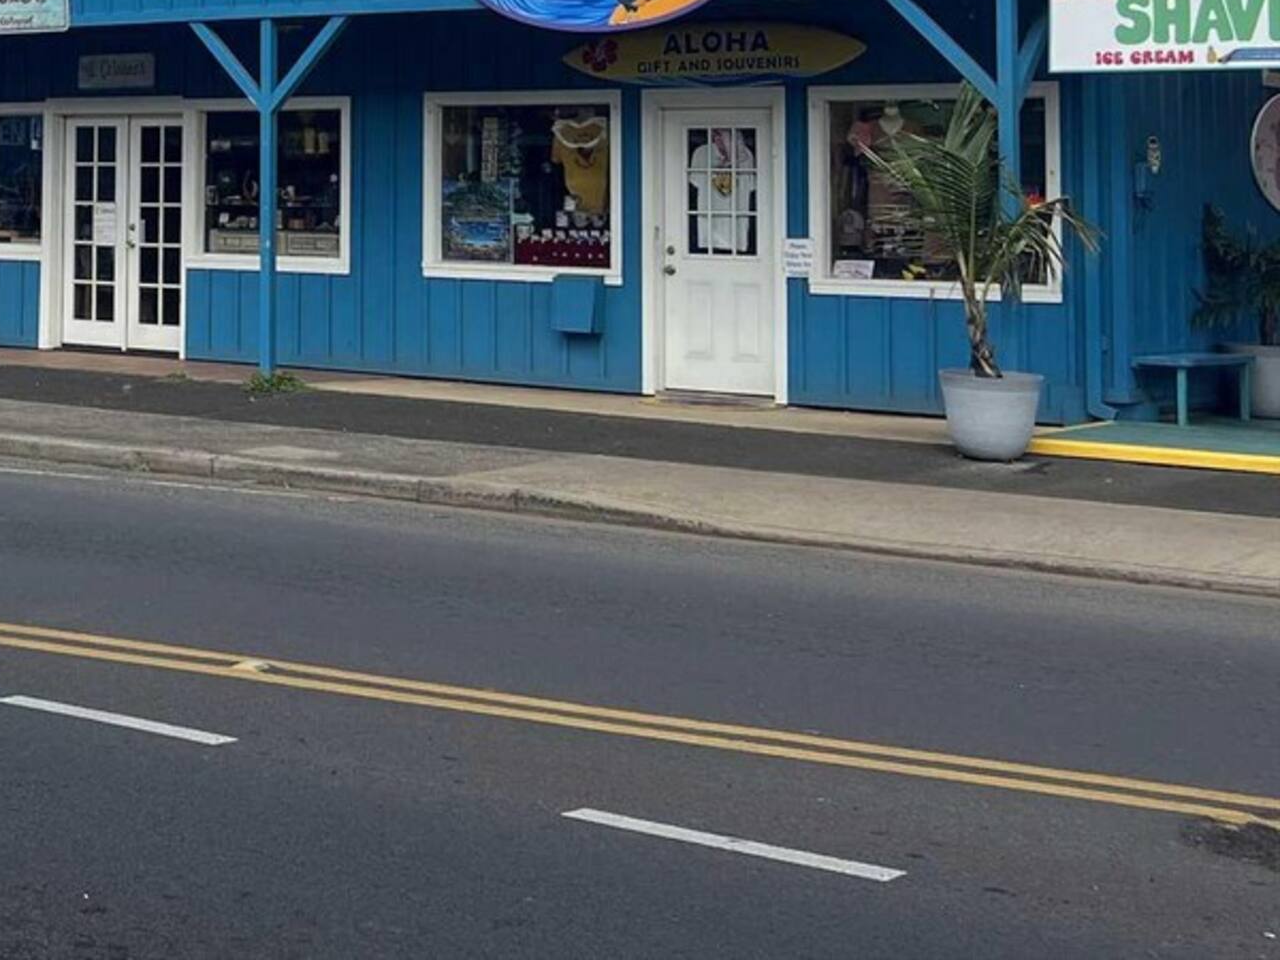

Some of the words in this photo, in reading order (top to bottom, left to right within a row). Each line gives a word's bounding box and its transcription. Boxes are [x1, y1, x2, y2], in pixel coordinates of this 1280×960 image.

[663, 30, 770, 55] ALOHA
[636, 60, 671, 74] GIFT
[678, 58, 711, 72] AND
[717, 55, 801, 71] SOUVENIRS
[1095, 51, 1124, 65] ICE
[1130, 49, 1194, 65] CREAM
